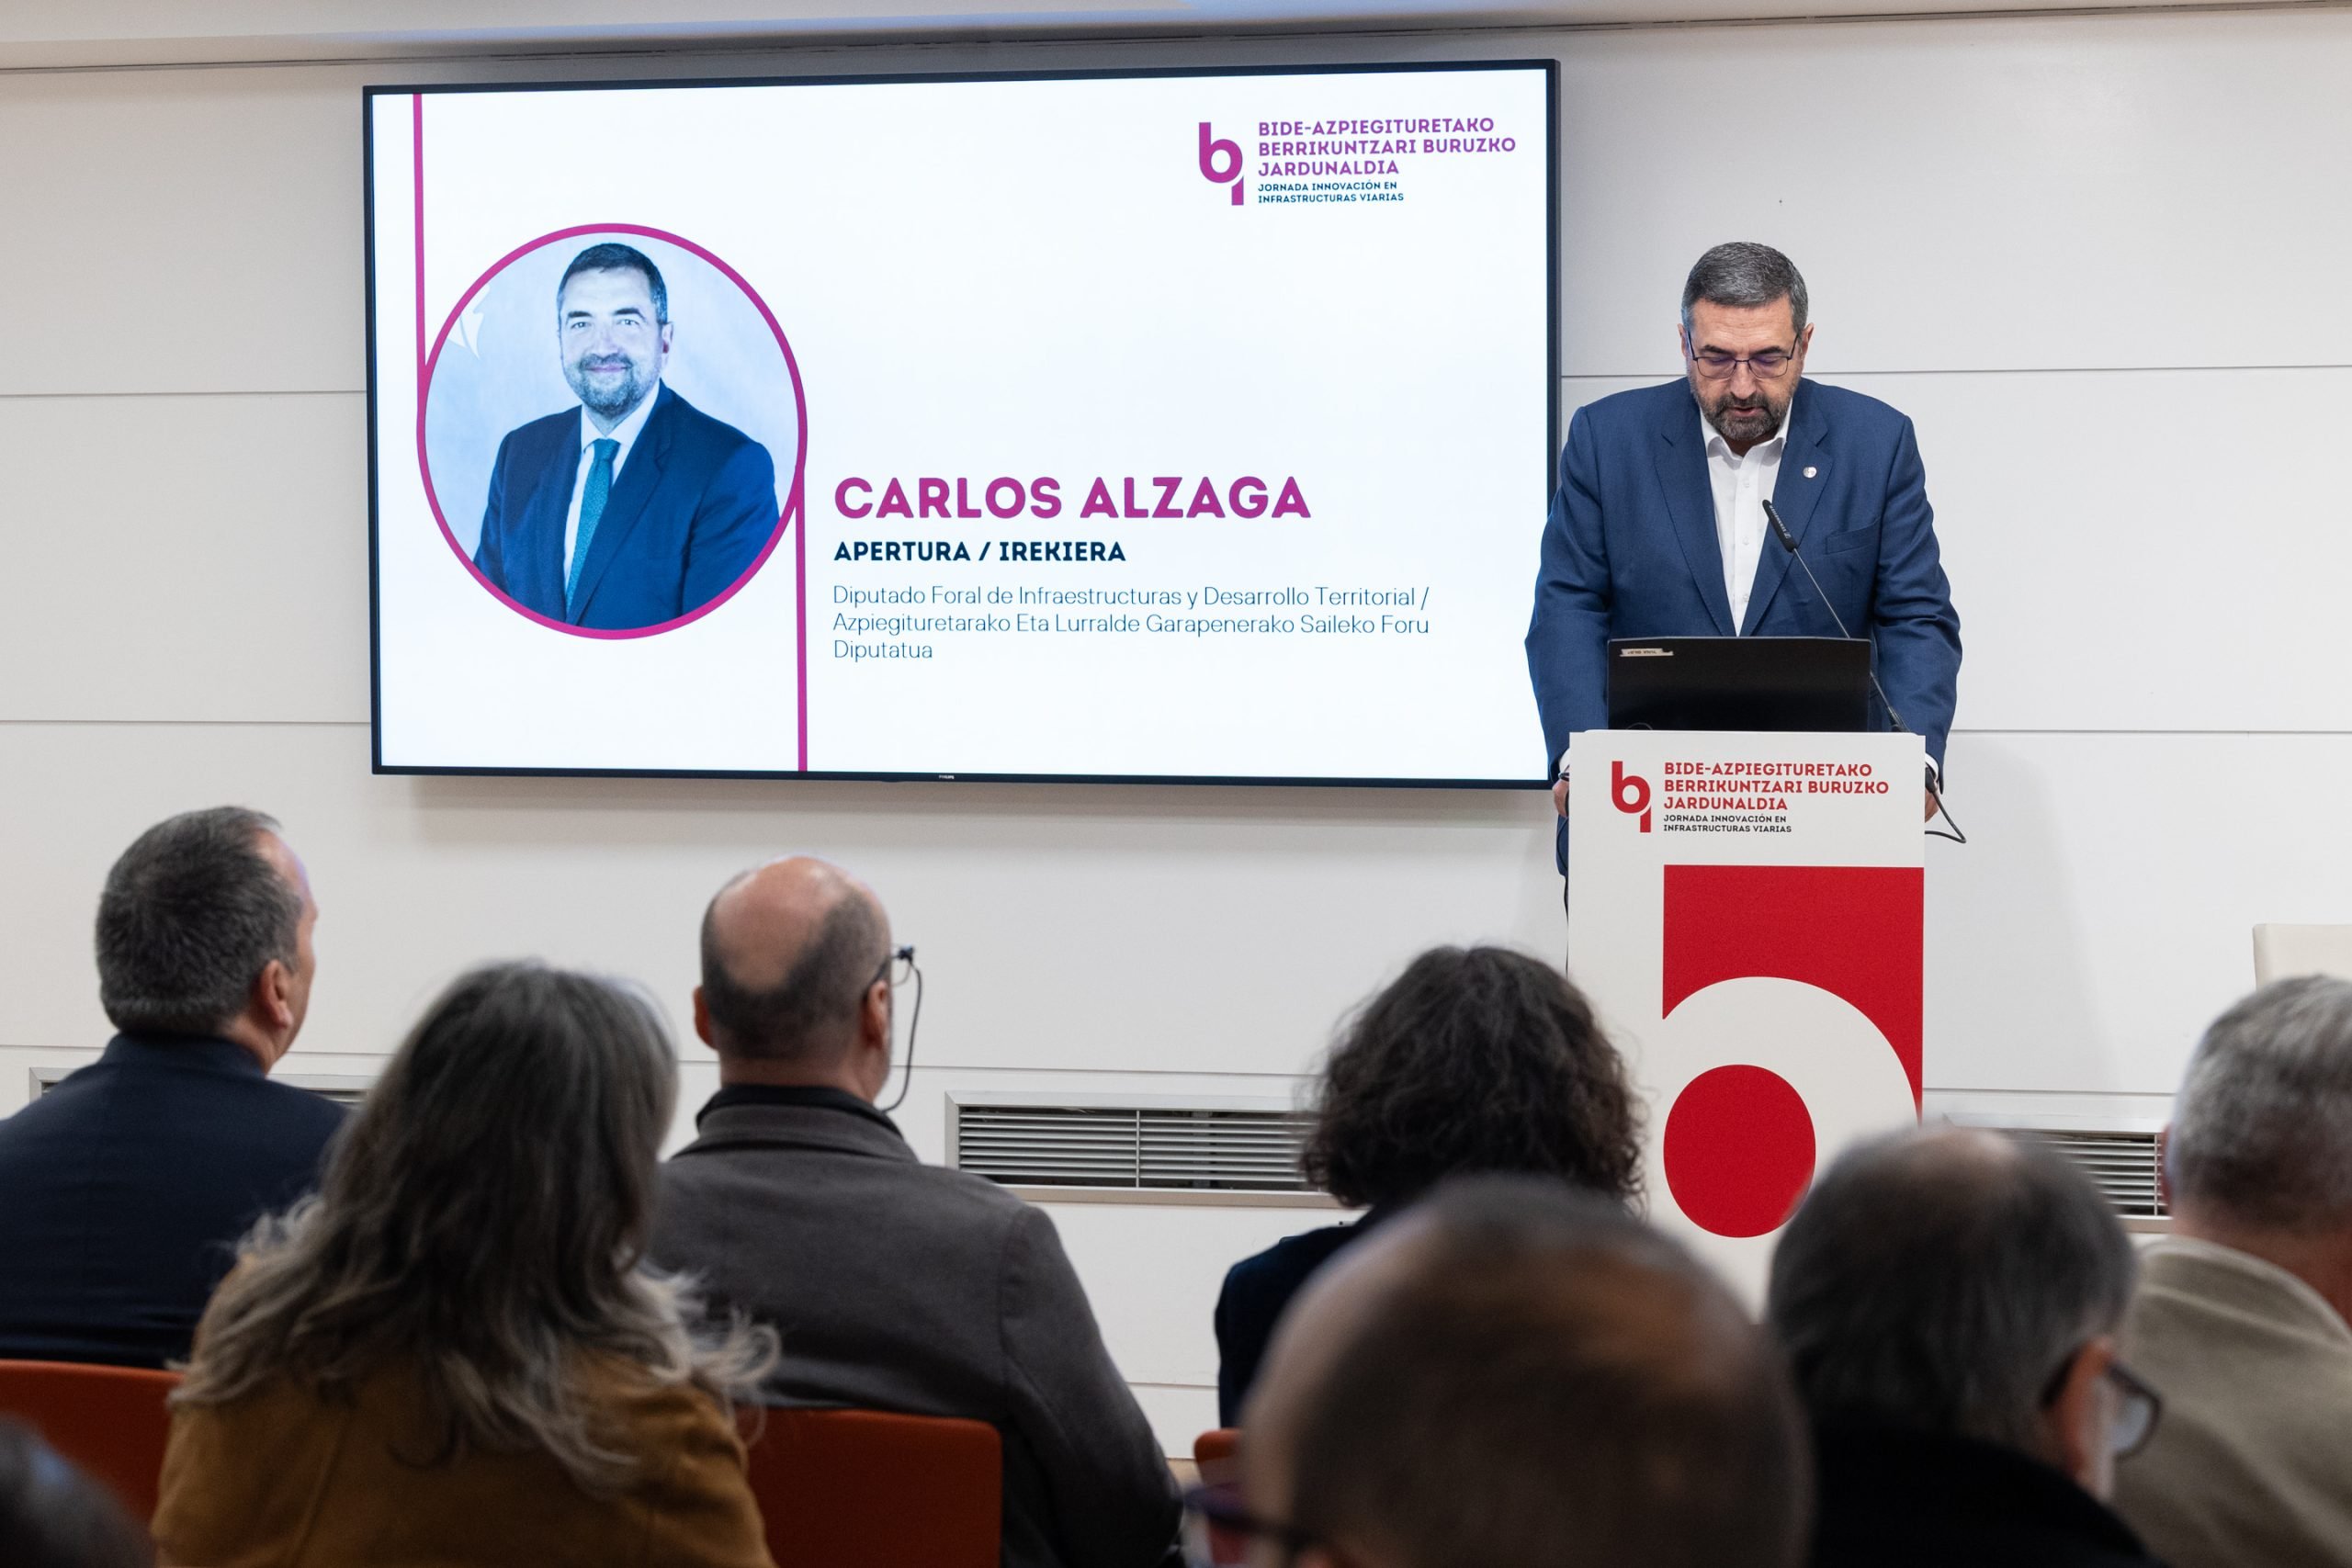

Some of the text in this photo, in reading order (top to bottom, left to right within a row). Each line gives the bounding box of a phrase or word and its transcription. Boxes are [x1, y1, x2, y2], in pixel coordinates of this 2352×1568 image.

[1258, 117, 1495, 137] BIDE-AZPIEGITURETAKO
[1259, 137, 1517, 157] BERRIKUNTZARI BURUZKO
[1258, 159, 1399, 177] JARDUNALDIA
[1257, 179, 1397, 192] JORNADA INNOVACIÓN EN
[1258, 192, 1405, 204] INFRASTRUCTURAS VIARIAS
[834, 475, 1312, 520] CARLOS ALZAGA
[832, 540, 1127, 562] APERTURA / IREKIERA
[833, 584, 1430, 611] Diputado Foral de Infraestructuras y Desarrollo Territorial /
[832, 612, 1429, 638] Azpiegituretarako Eta Lurralde Garapenerako Saileko Foru
[834, 639, 933, 663] Diputatua
[1664, 761, 1873, 778] BIDE-AZPIEGITURETAKO
[1664, 779, 1890, 795] BERRIKUNTZARI BURUZKO
[1663, 796, 1789, 811] JARDUNALDIA
[1663, 813, 1787, 824] JORNADA INNOVACIÓN EN
[1663, 824, 1792, 834] INFRASTRUCTURAS VIARIAS
